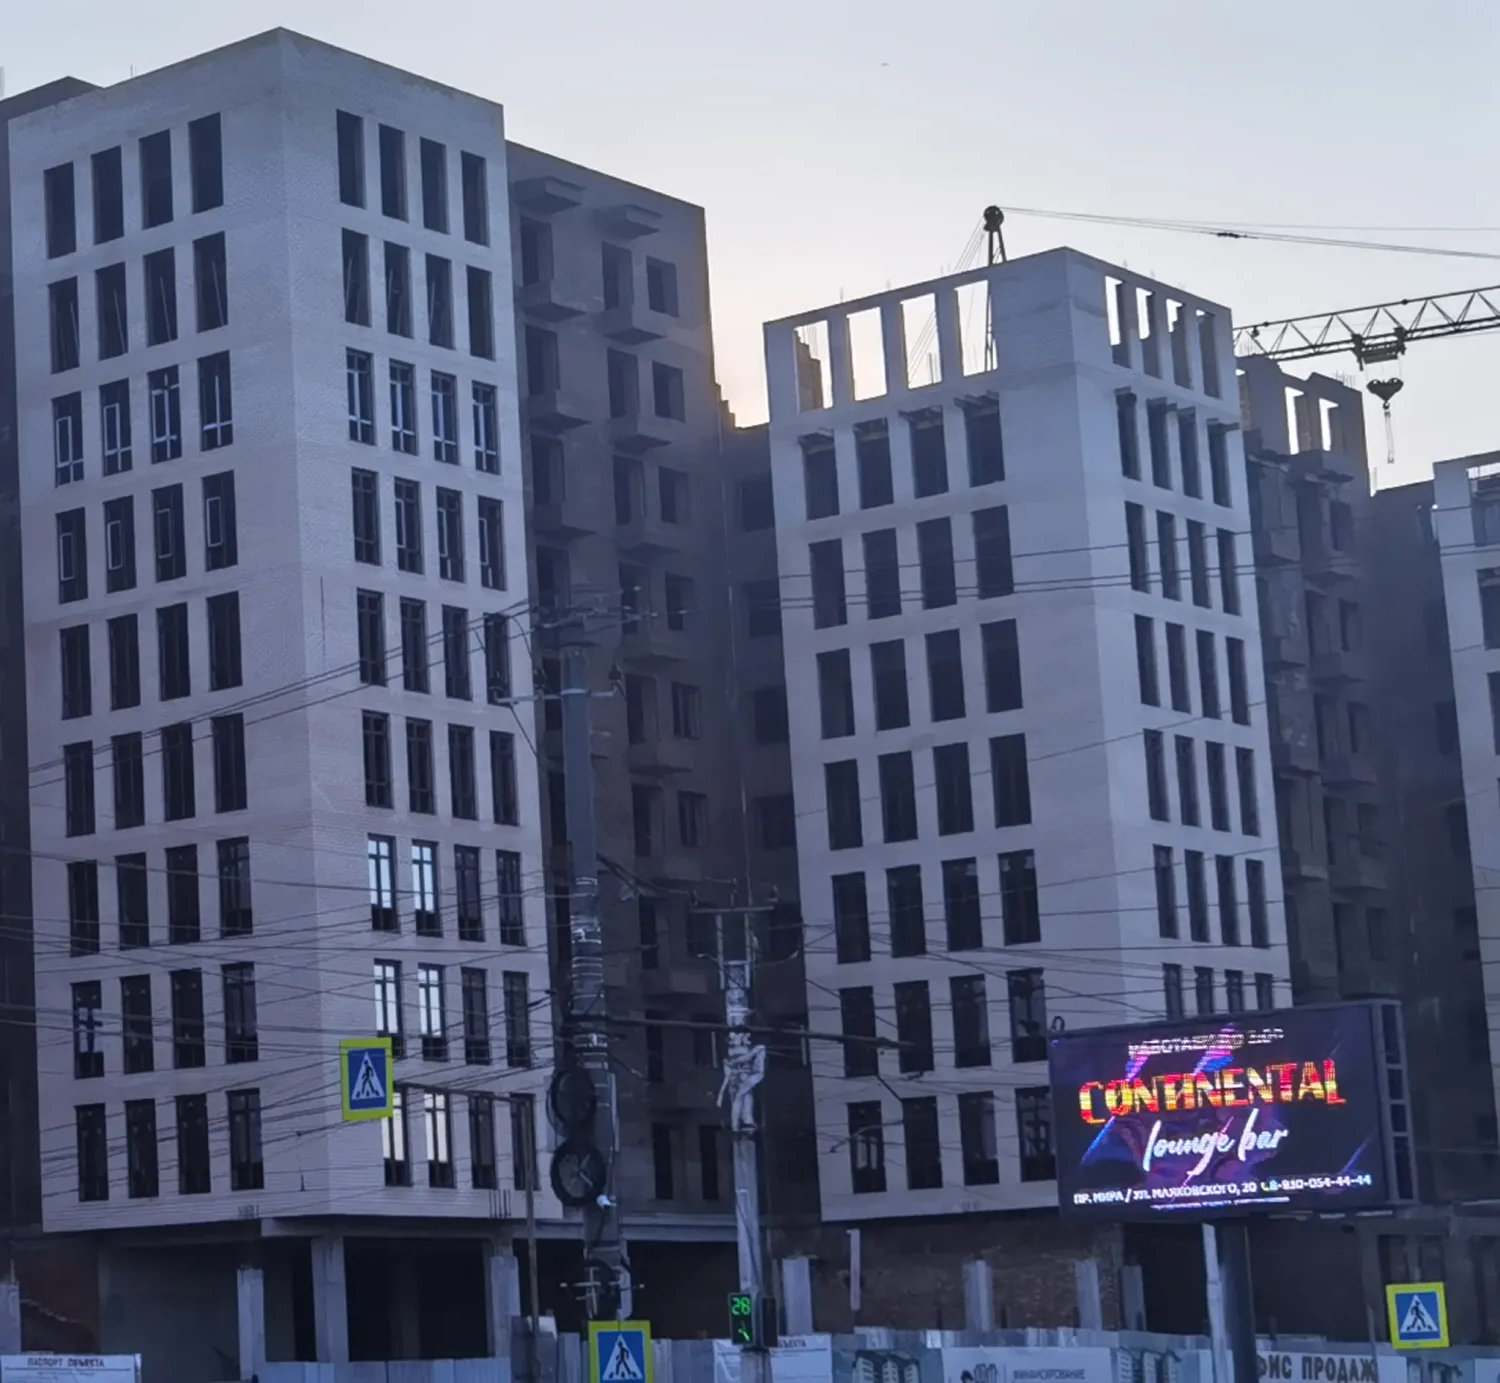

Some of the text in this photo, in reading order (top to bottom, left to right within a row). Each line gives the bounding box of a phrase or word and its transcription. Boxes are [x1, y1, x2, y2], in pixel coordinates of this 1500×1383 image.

[1079, 1058, 1346, 1125] CONTINENTAL
[1143, 1107, 1289, 1177] lounge bar
[1092, 1190, 1124, 1203] МИРА
